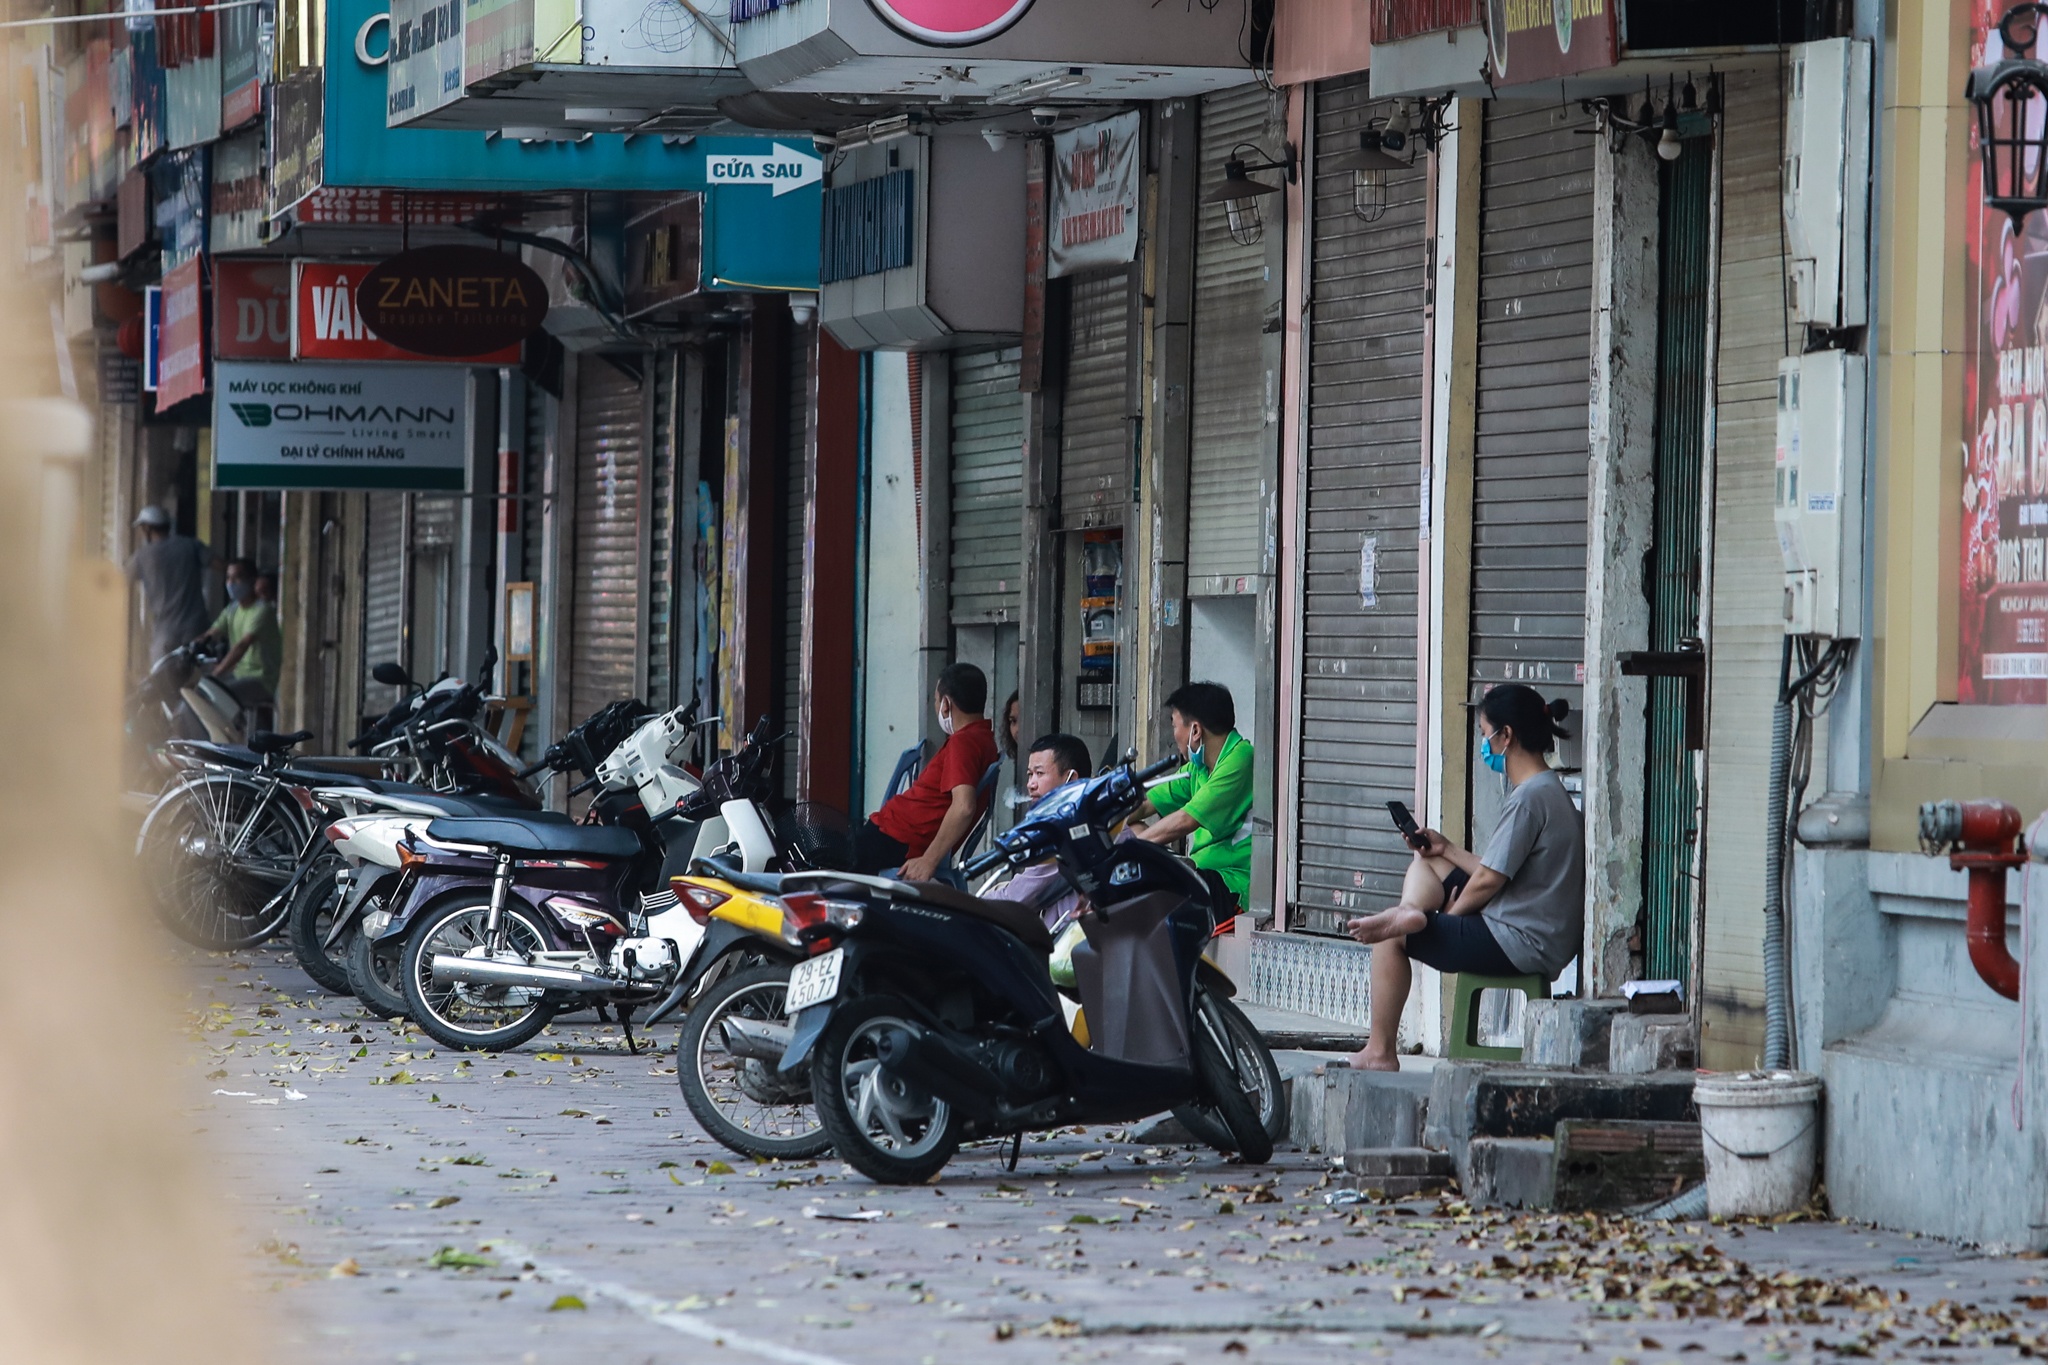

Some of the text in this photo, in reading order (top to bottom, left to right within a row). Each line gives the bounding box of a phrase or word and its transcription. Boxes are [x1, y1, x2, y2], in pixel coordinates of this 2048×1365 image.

[712, 157, 803, 179] CỬA SAU
[378, 277, 529, 308] ZANETA
[229, 380, 362, 395] MÁY LỌC KHÔNG KHÍ
[229, 402, 455, 427] BOHMANN
[352, 428, 451, 439] Living Smart
[280, 444, 405, 460] ĐẠI LÝ CHÍNH HÃNG
[798, 955, 835, 985] 29-E2
[790, 975, 836, 1007] 450.77
